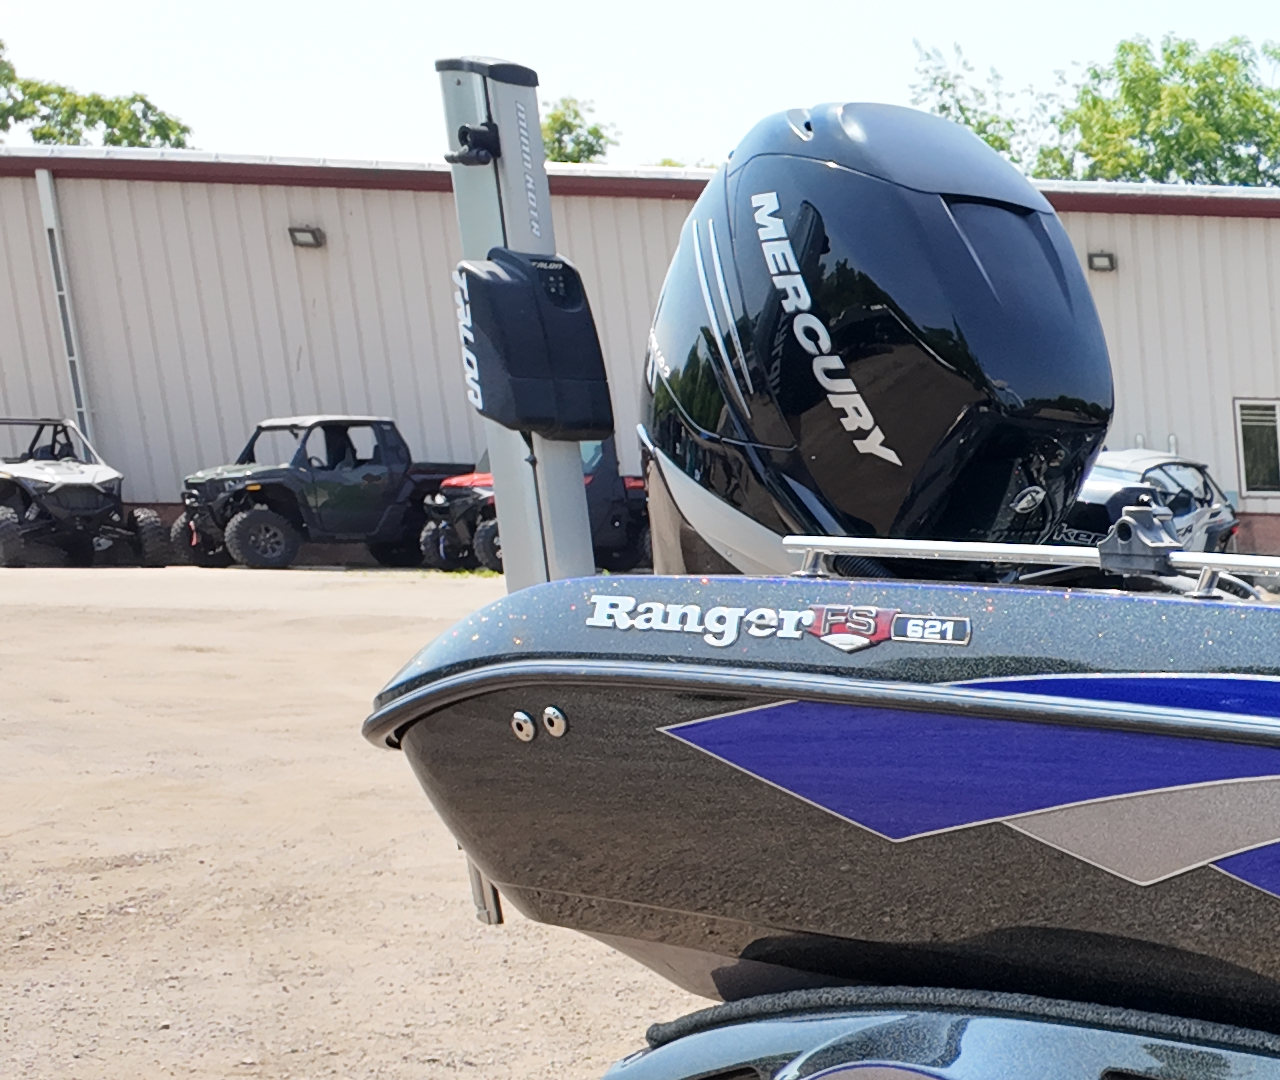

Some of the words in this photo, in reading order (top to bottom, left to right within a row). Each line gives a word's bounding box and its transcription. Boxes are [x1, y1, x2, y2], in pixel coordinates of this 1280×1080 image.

[523, 171, 541, 238] KOTA
[452, 270, 483, 410] TALON
[751, 191, 902, 466] MERCURY
[585, 594, 816, 648] Ranger
[820, 604, 879, 636] FS
[906, 619, 954, 641] 621
